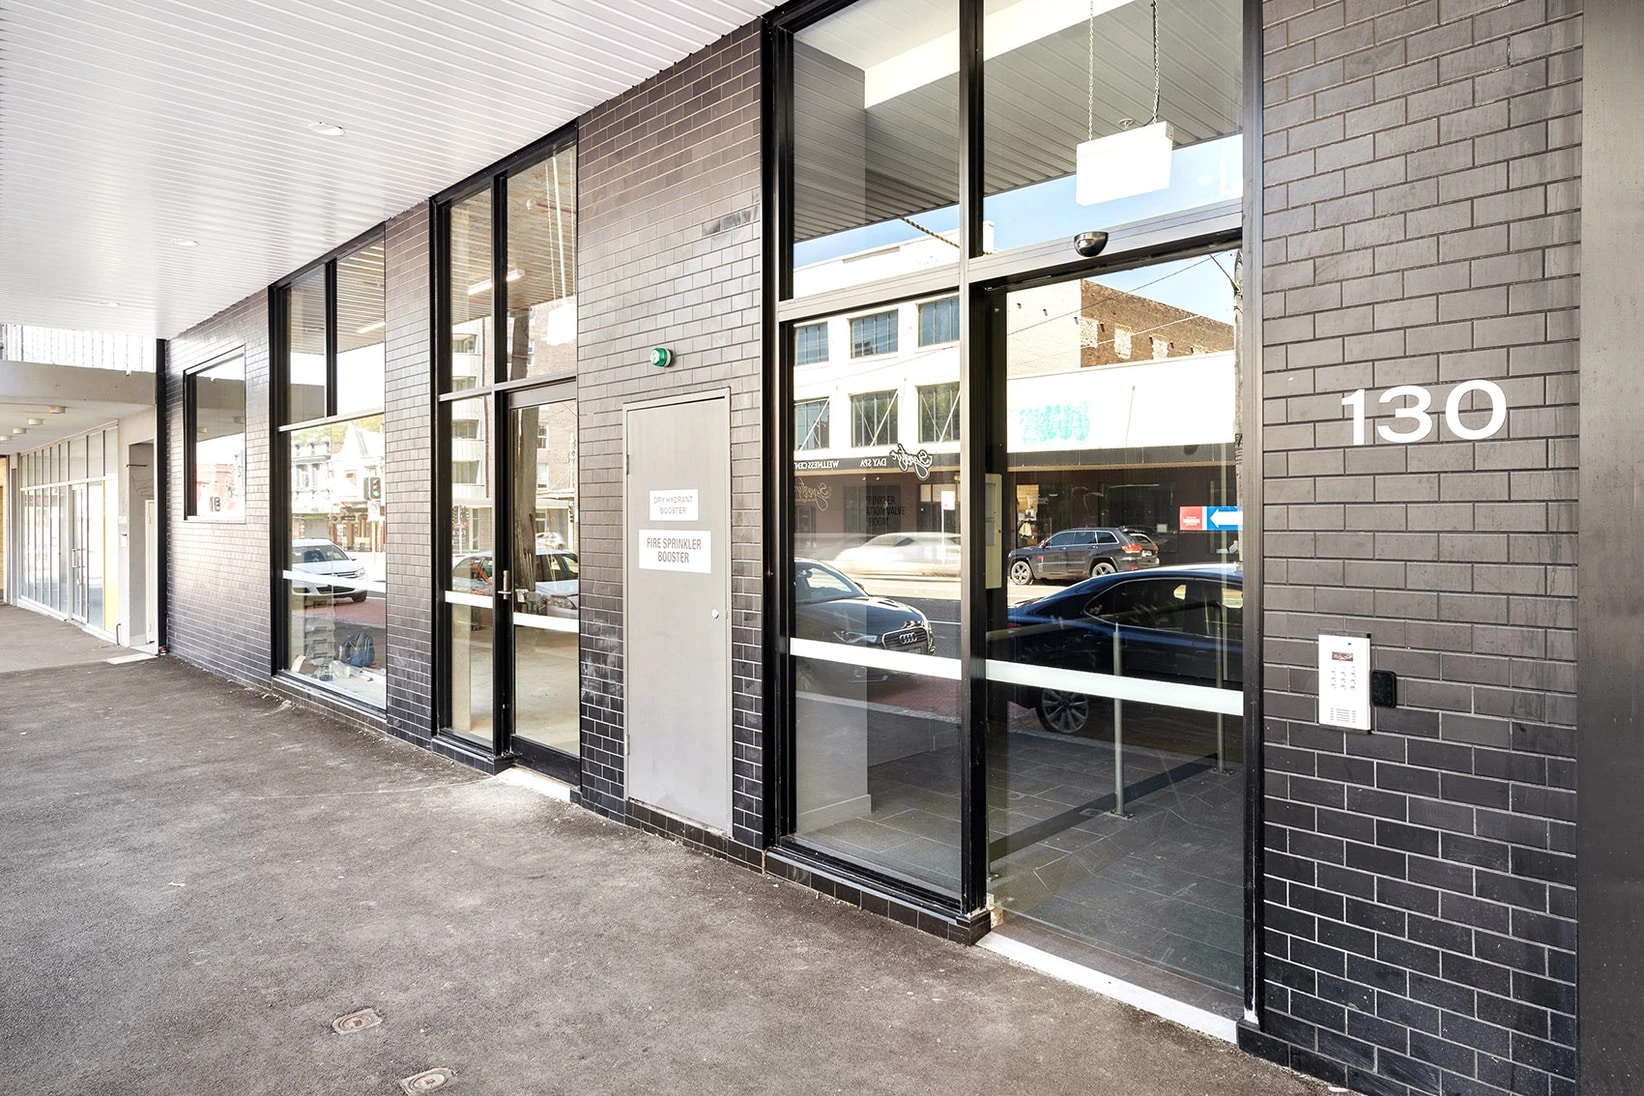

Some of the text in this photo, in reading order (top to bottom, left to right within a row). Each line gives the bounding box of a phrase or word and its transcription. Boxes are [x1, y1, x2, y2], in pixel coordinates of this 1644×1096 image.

[1341, 379, 1507, 446] 130
[653, 495, 693, 504] DRY HYDRANT
[659, 506, 687, 515] BOOSTER
[646, 537, 702, 550] FIRE SPRINKLER
[657, 551, 690, 564] BOOSTER
